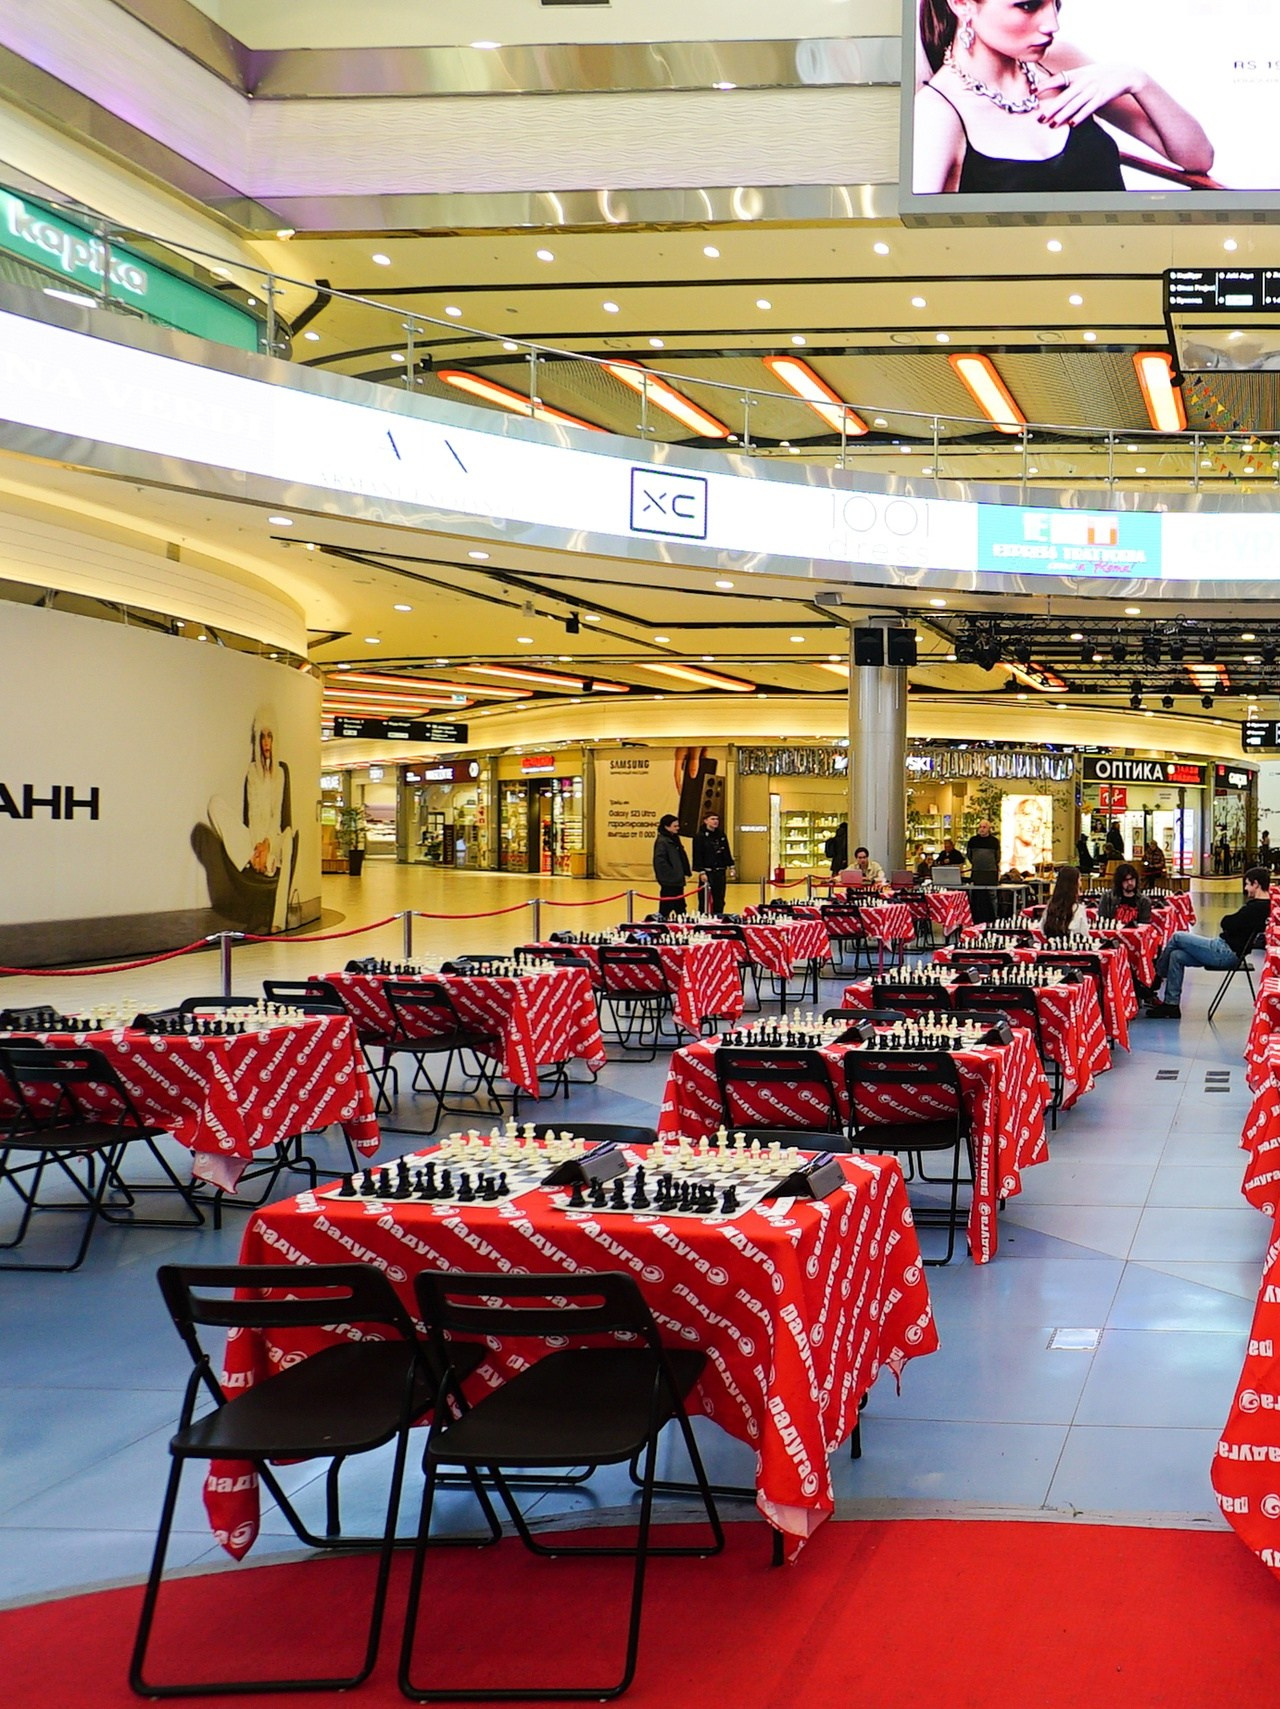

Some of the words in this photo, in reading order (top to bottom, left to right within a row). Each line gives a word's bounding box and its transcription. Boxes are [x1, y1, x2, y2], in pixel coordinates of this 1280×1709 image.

[1233, 59, 1257, 71] RS
[830, 492, 932, 539] 1001
[610, 760, 650, 770] SAMSUNG
[1095, 760, 1164, 782] ОПТИКА
[132, 1053, 172, 1090] радуга
[206, 1051, 235, 1095] радуга
[979, 1141, 990, 1196] радуга
[313, 1215, 396, 1272] радуга
[377, 1214, 452, 1272] радуга
[442, 1216, 518, 1273] радуга
[510, 1218, 578, 1273] радуга
[979, 1216, 990, 1264] радуга
[672, 1283, 741, 1340] радуга
[779, 1304, 815, 1384] радуга
[706, 1346, 752, 1420] радуга
[768, 1396, 812, 1480] радуга
